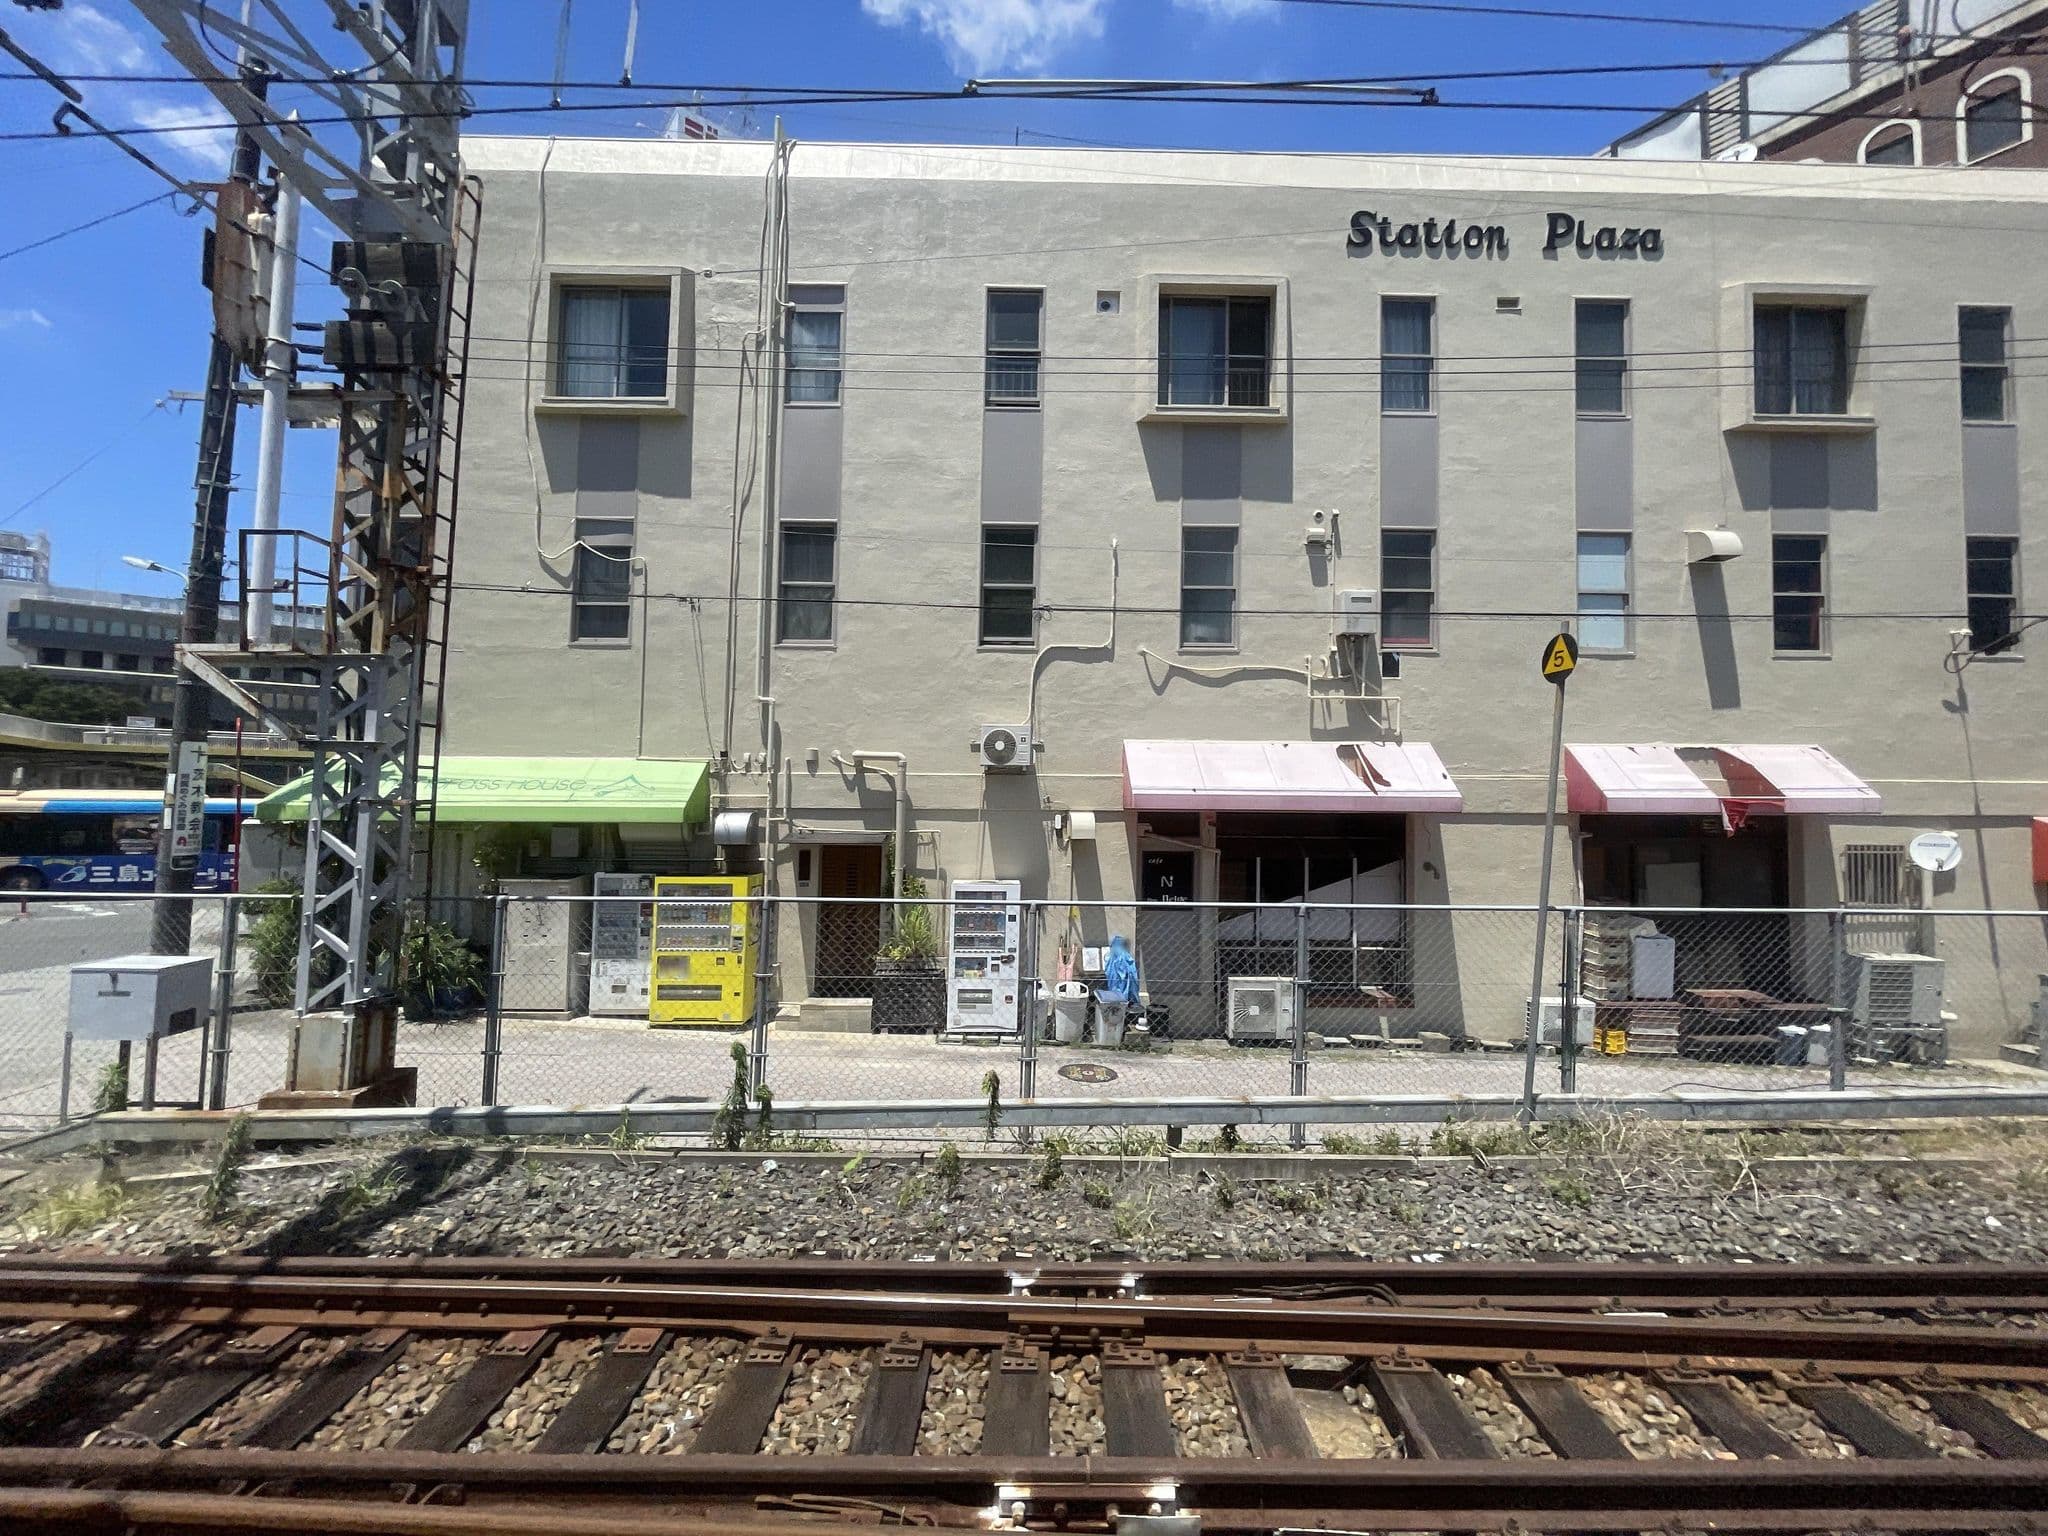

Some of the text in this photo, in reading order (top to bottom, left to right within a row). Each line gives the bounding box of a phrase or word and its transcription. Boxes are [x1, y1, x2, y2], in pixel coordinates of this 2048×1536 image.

[1346, 210, 1664, 250] Station Plaza
[1553, 650, 1565, 668] 5
